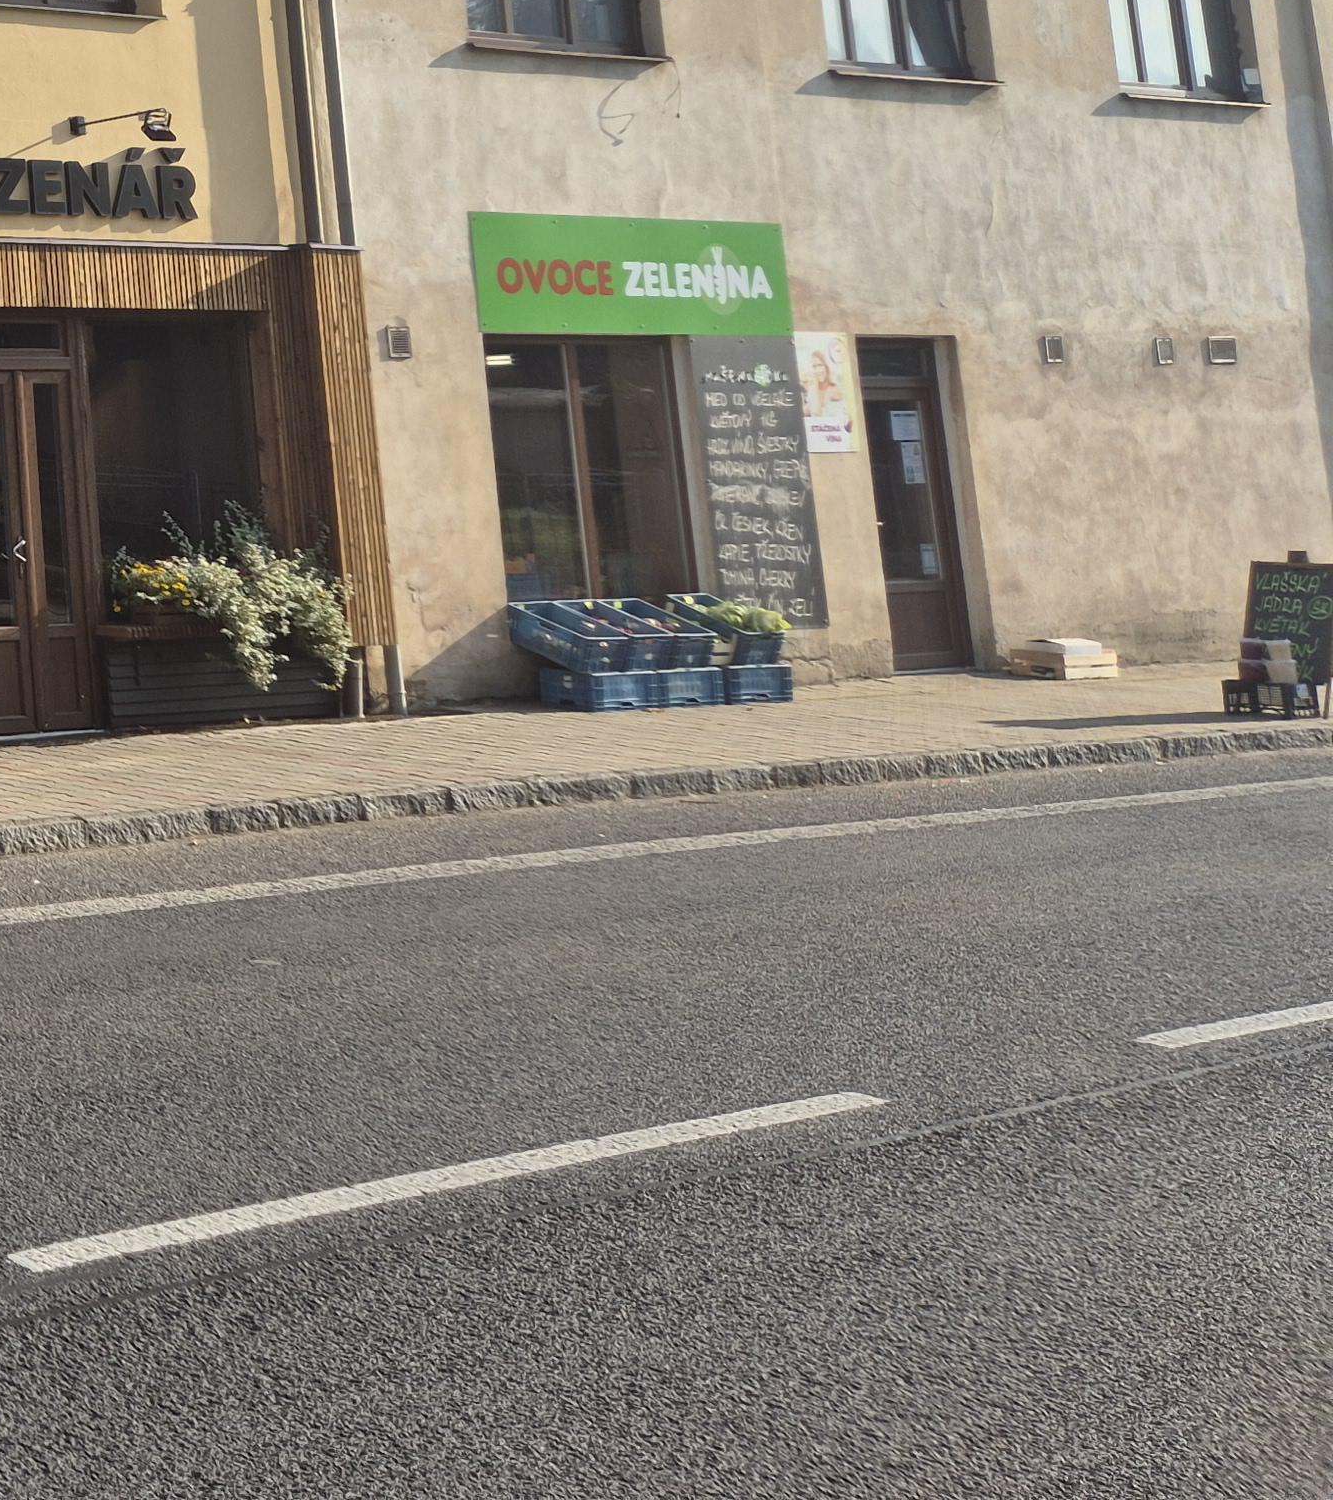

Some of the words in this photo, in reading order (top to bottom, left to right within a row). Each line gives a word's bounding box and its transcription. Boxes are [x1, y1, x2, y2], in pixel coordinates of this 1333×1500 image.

[496, 257, 614, 296] OVOCE
[622, 250, 773, 303] ZELENINA
[1254, 614, 1310, 636] KVĚTÁK
